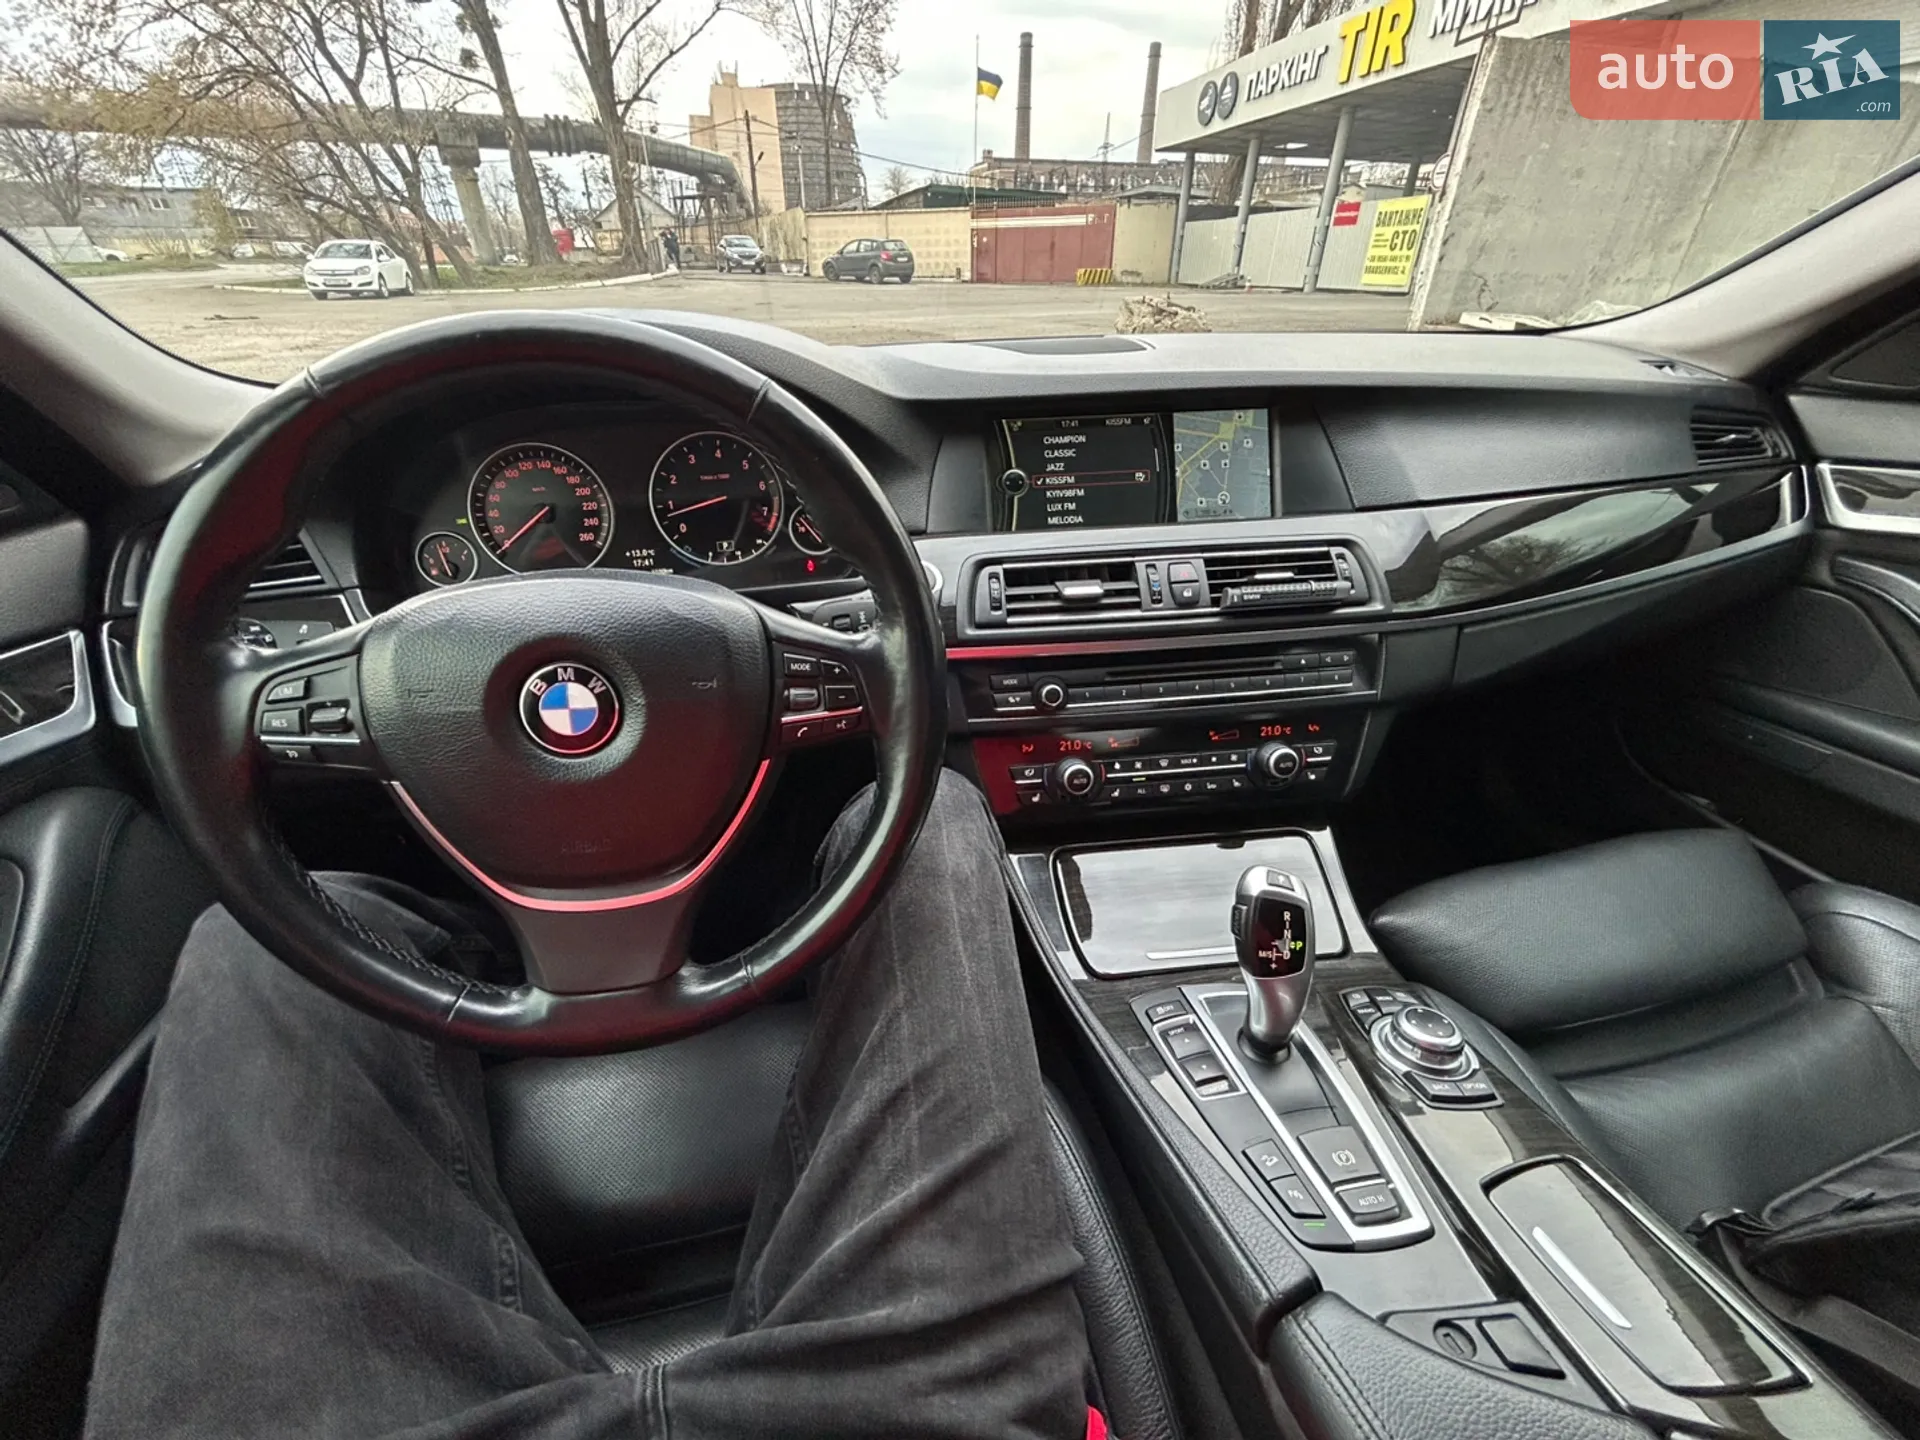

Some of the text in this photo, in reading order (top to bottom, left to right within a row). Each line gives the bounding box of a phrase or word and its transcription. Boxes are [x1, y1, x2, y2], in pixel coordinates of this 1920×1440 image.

[1246, 45, 1328, 101] ПАРКІНГ
[1338, 0, 1415, 84] TIR
[1389, 229, 1418, 251] СТО
[1061, 418, 1131, 428] 17:41 KISSFM
[1043, 435, 1086, 444] CHAMPION
[714, 449, 722, 458] 4
[1044, 448, 1076, 458] CLASSIC
[688, 455, 696, 464] 3
[742, 460, 749, 470] 5
[1046, 463, 1065, 471] JAZZ
[669, 474, 677, 484] 2
[1045, 476, 1075, 485] KISSFM
[758, 481, 766, 491] 6
[575, 487, 591, 496] 200
[582, 502, 597, 511] 220
[1047, 502, 1076, 511] LUX FM
[583, 518, 599, 526] 240
[1047, 515, 1083, 525] MELODIA
[679, 523, 687, 533] 0
[579, 533, 594, 541] 260
[790, 662, 811, 671] MODE
[529, 667, 607, 696] BMW
[271, 718, 287, 727] RES
[1260, 725, 1281, 736] 21.0
[1060, 740, 1082, 751] 21.0
[1283, 911, 1291, 921] R
[1283, 930, 1291, 939] N
[1296, 941, 1303, 950] P
[1283, 950, 1290, 960] D
[1359, 1196, 1378, 1206] AUTO
